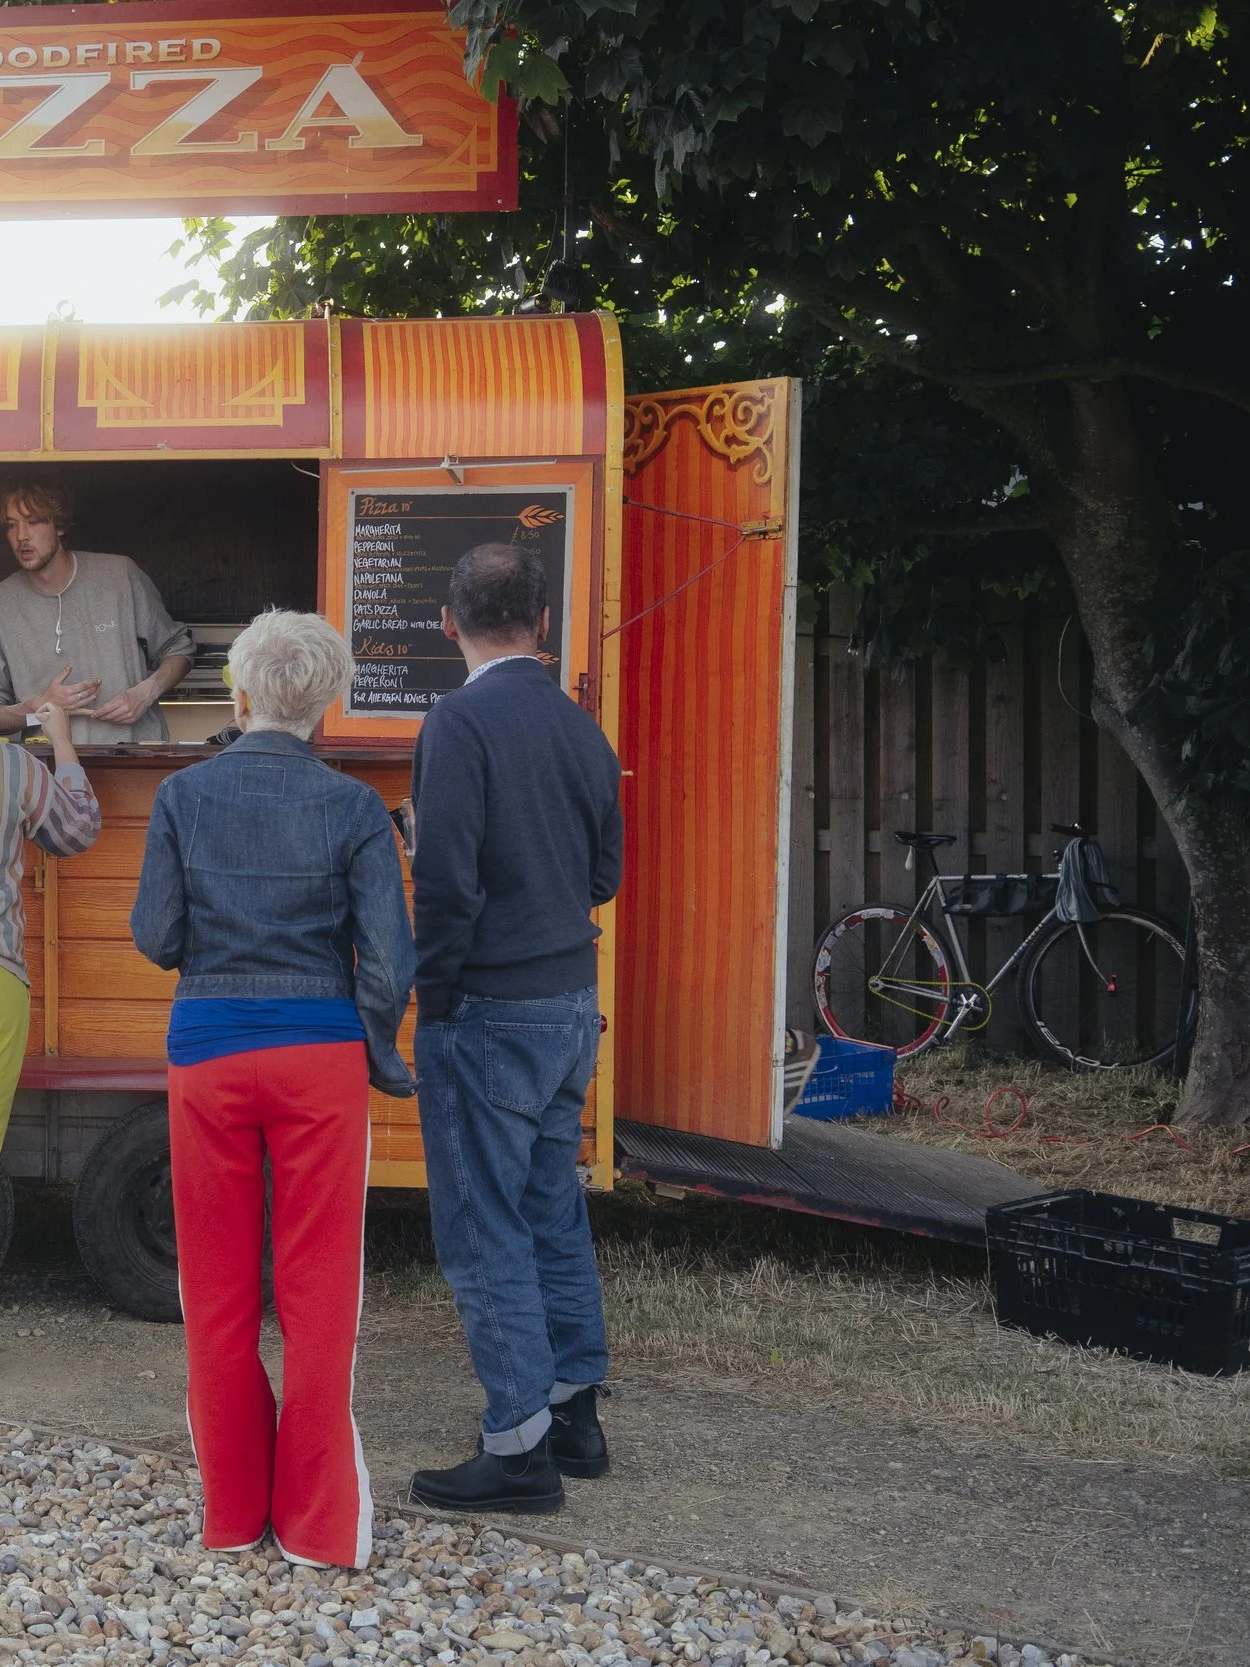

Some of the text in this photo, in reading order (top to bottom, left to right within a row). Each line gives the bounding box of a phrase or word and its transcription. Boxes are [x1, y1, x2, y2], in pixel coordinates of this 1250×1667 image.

[358, 496, 399, 516] Pizza
[355, 523, 402, 538] MARGHERITA
[354, 541, 395, 554] PEPPERONI
[353, 556, 403, 569] VEGETARIAN
[353, 572, 405, 586] NAPOLETANA
[354, 588, 387, 600] DIAVOLA
[374, 604, 399, 617] PIZZA
[353, 618, 381, 632] GARLIC
[382, 619, 408, 630] BREAD
[355, 635, 394, 656] Kids
[355, 662, 408, 677] MARGHERITA
[353, 675, 404, 689] PEPPERONI
